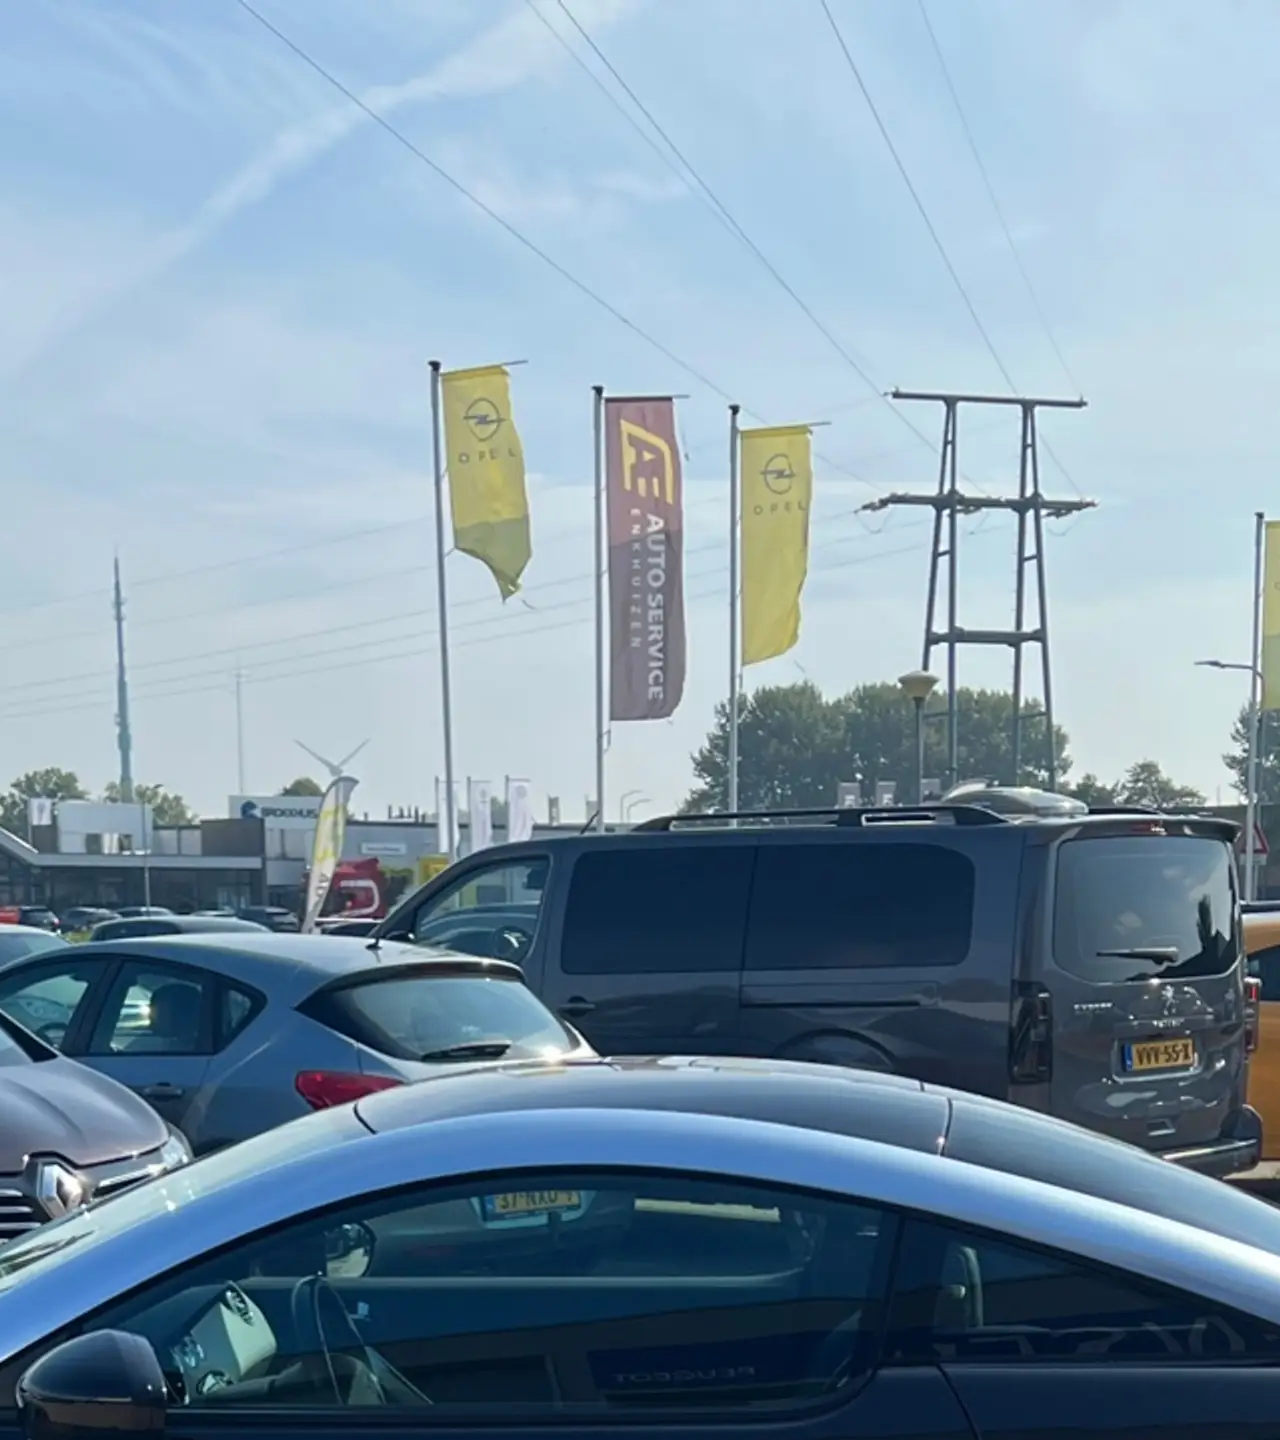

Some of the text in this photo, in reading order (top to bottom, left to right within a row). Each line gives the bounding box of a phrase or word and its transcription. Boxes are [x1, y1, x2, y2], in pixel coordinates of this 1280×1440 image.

[458, 448, 517, 465] OPEL
[753, 500, 808, 516] OPEL
[630, 507, 642, 648] ENKHUIZEN
